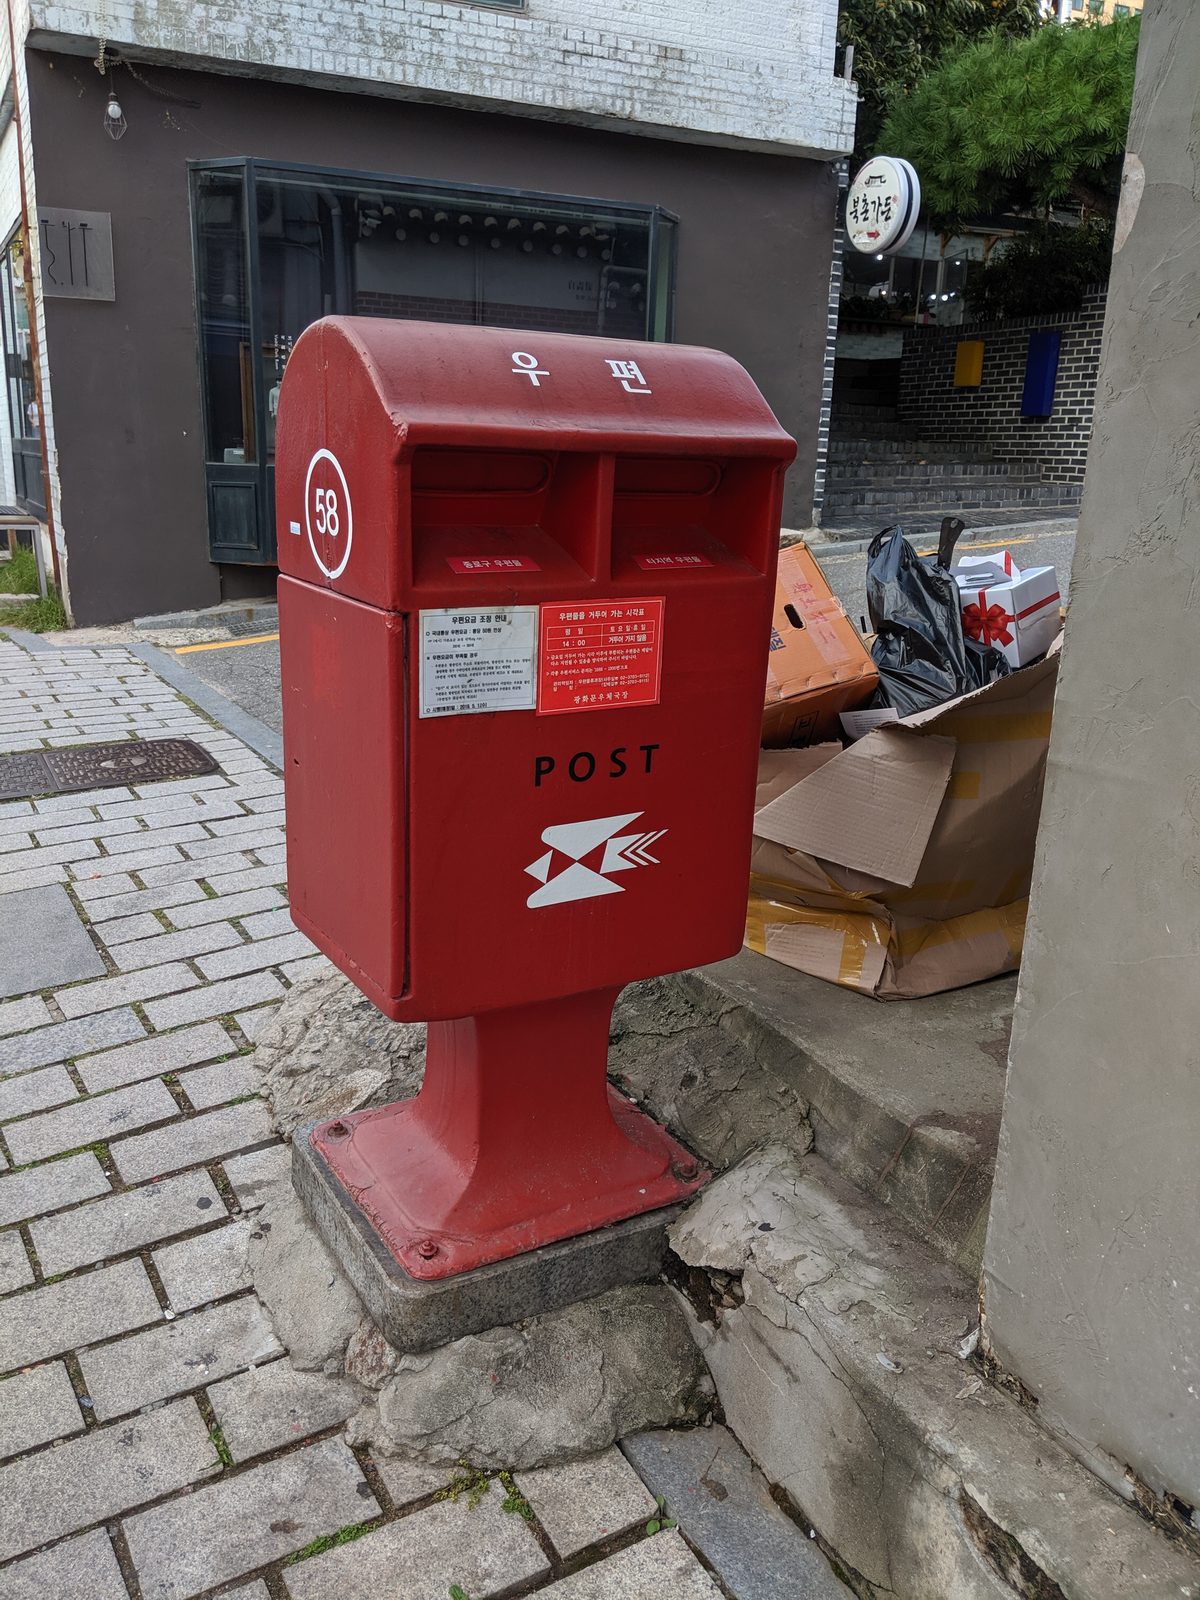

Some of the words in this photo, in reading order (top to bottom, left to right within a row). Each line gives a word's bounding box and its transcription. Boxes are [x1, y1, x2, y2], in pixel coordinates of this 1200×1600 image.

[315, 488, 339, 537] 58
[462, 560, 491, 568] 종로구
[452, 616, 477, 625] 우편요금
[480, 615, 492, 623] 조정
[495, 614, 507, 622] 안내
[559, 611, 585, 621] 우편물을
[589, 610, 608, 619] 거두어
[611, 609, 623, 617] 가는
[626, 608, 645, 617] 시각표
[608, 635, 624, 643] 거두어
[534, 744, 660, 787] POST
